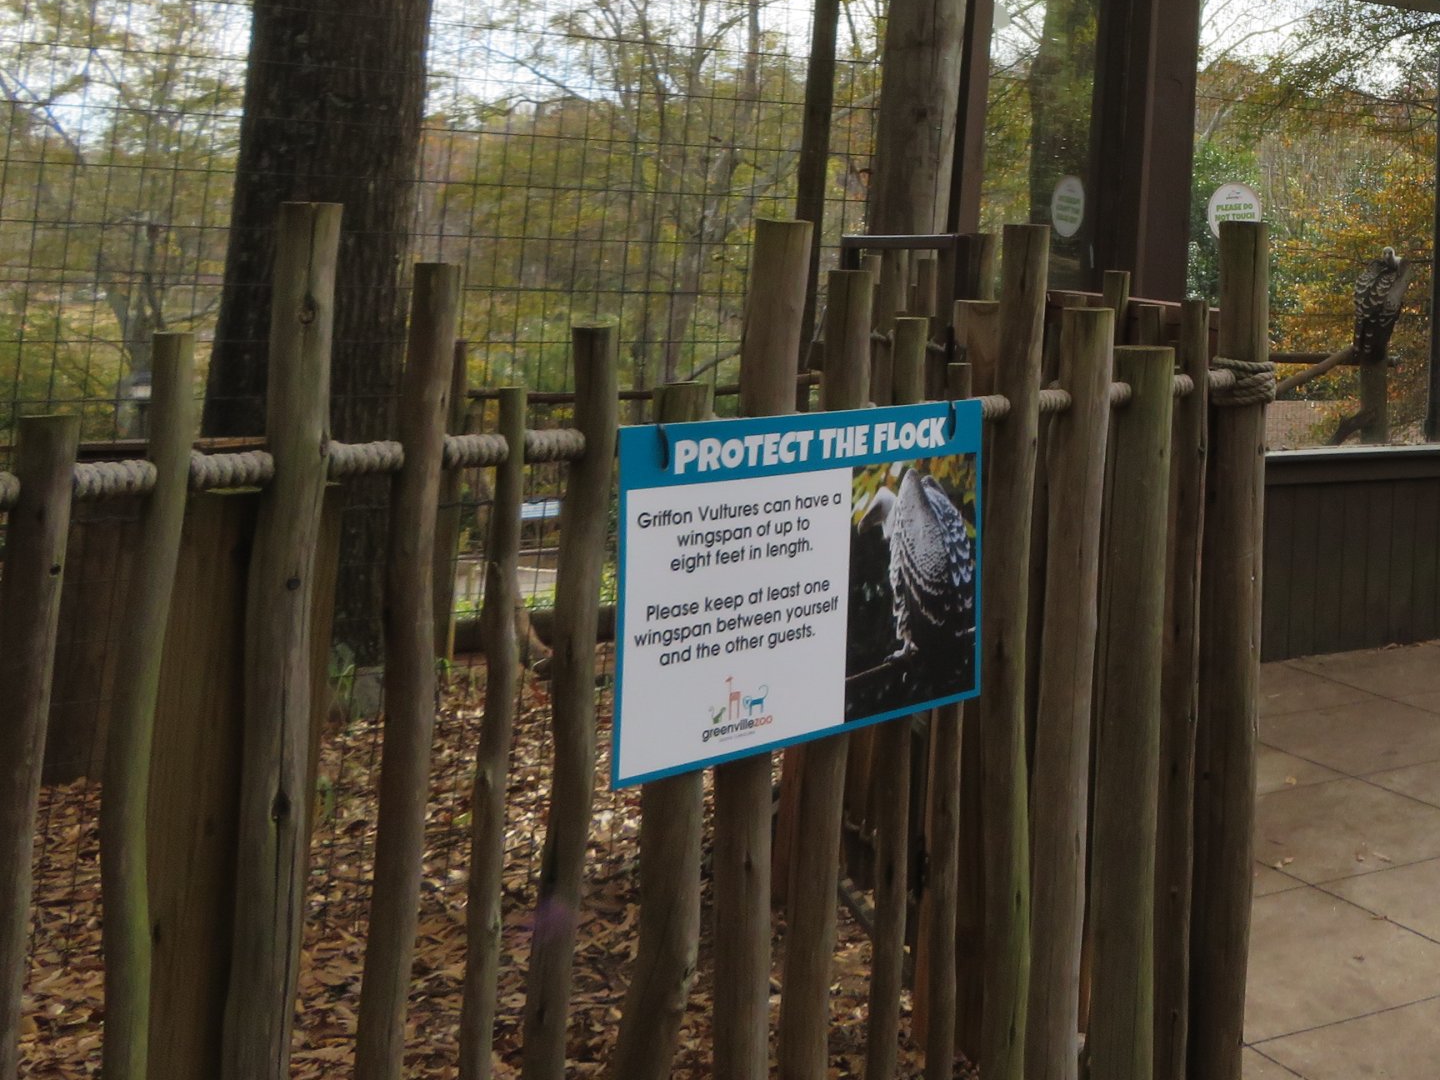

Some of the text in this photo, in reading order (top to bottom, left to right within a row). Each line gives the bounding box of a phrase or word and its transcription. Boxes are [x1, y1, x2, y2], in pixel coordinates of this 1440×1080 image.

[1216, 203, 1242, 211] PLEASE
[674, 417, 946, 475] PROTECT THE FLOCK
[637, 492, 842, 528] Griffon Vultures can have a
[677, 517, 810, 548] wingspan of up to
[670, 537, 813, 573] eight feet in length.
[646, 579, 830, 622] Please keep at least one
[634, 595, 839, 647] wingspan between yourself
[659, 623, 816, 666] and the other guests.
[702, 714, 773, 743] greenvillezoo
